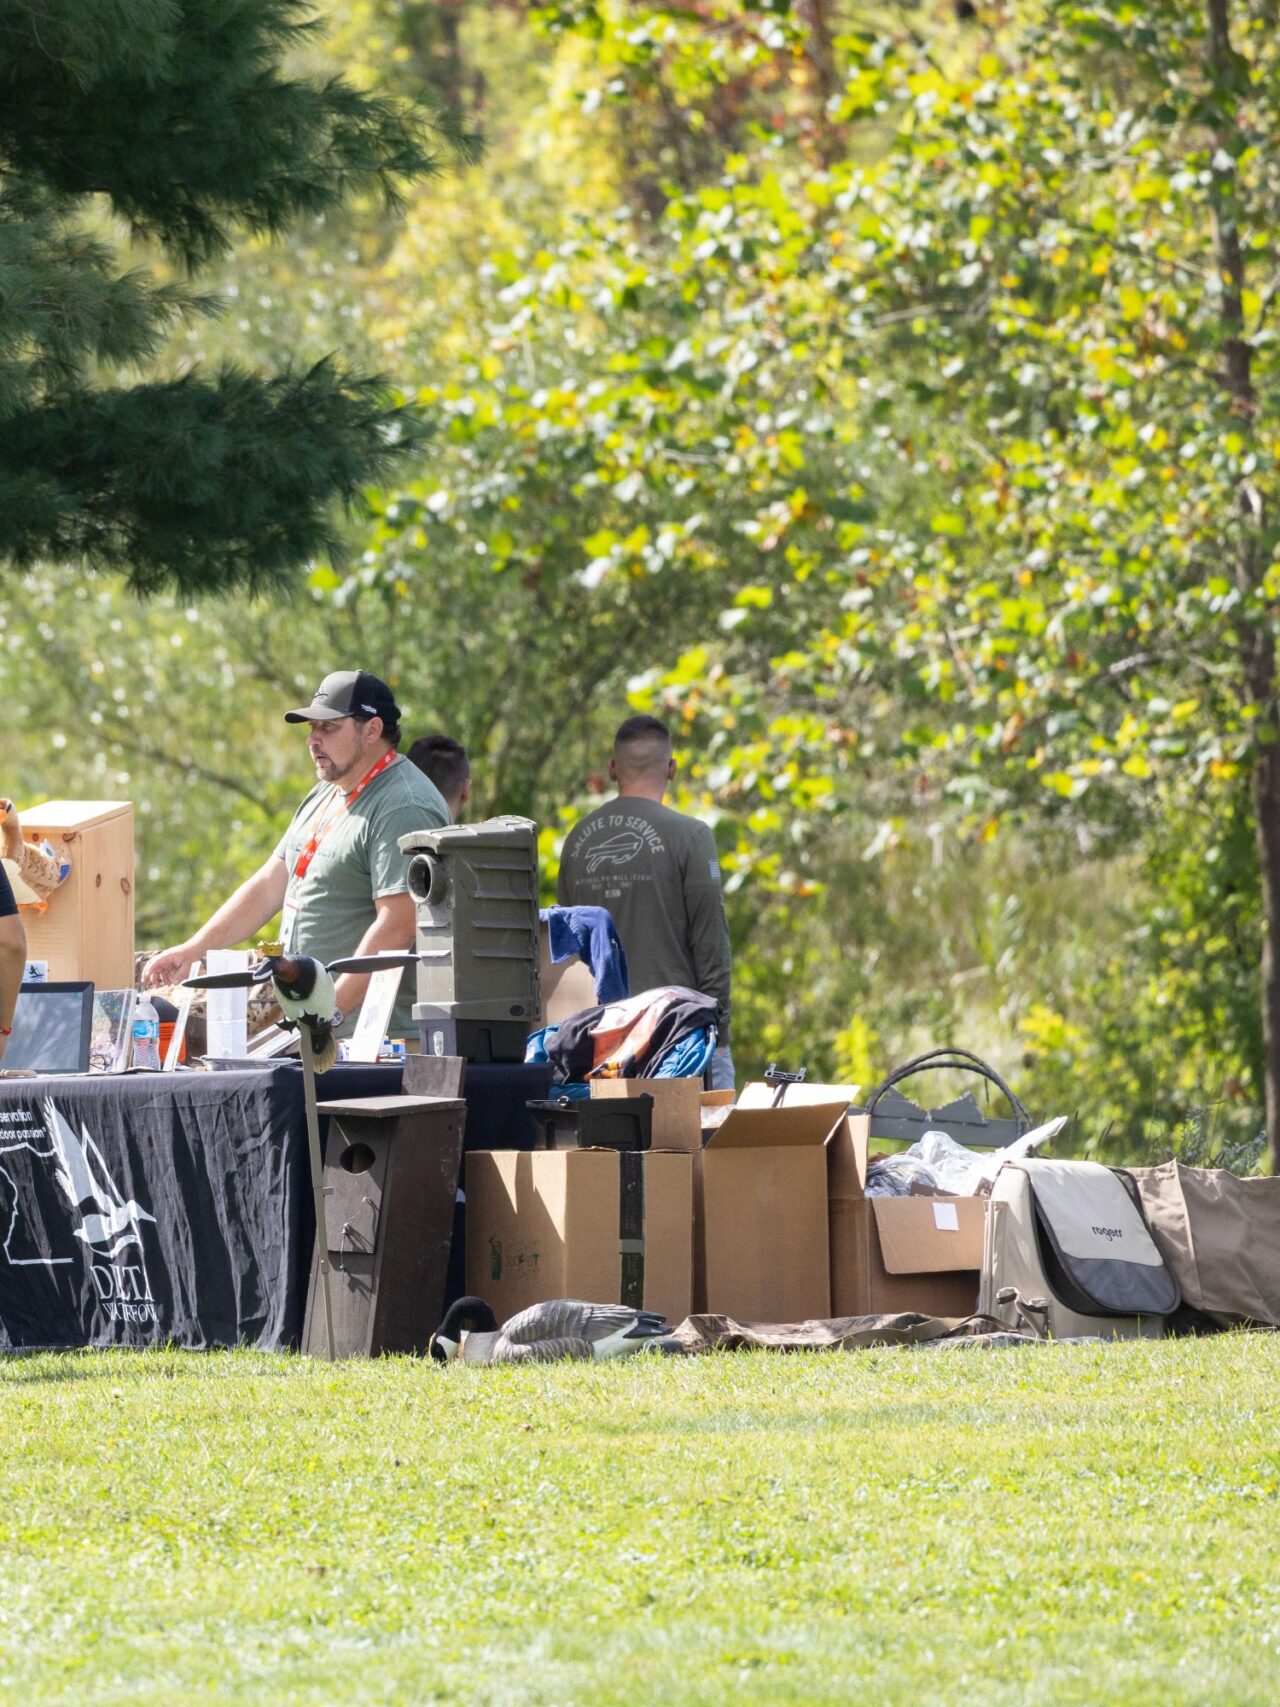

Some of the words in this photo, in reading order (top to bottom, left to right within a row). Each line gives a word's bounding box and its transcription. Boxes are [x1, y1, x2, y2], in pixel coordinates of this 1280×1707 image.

[571, 817, 605, 859] SALUTE
[608, 815, 624, 826] TO
[625, 816, 665, 854] SERVICE
[1091, 1226, 1123, 1242] rogers
